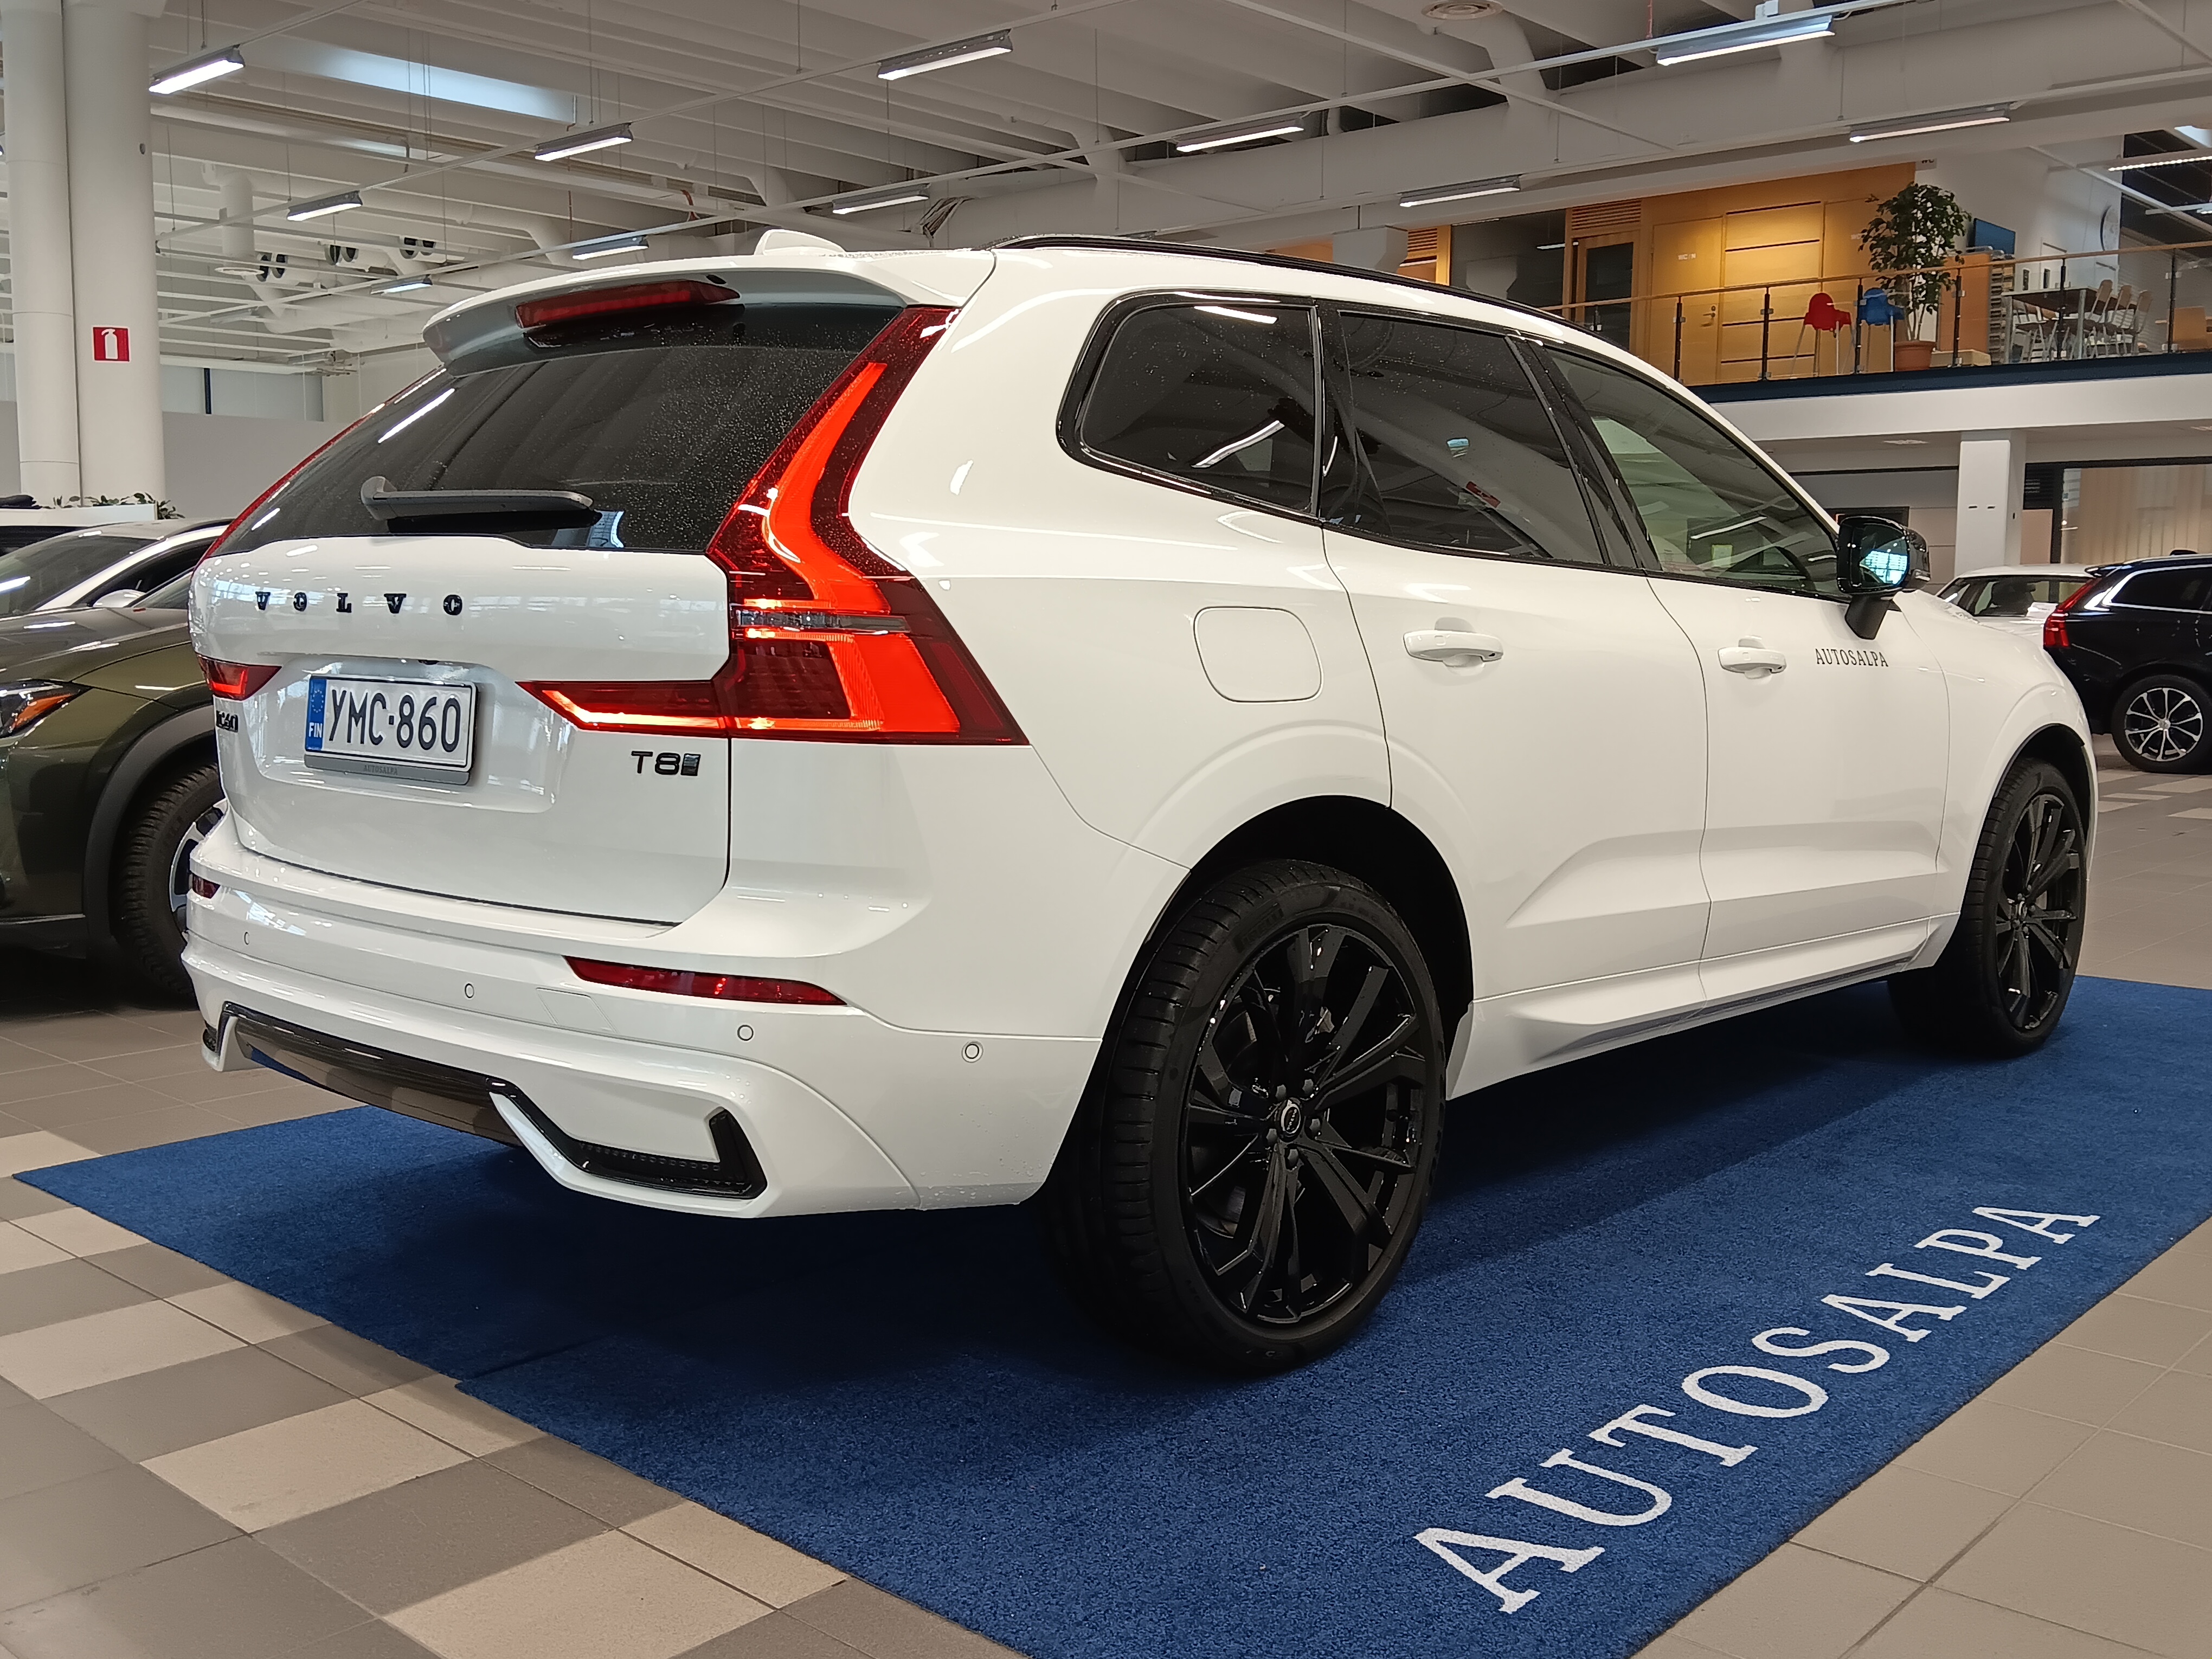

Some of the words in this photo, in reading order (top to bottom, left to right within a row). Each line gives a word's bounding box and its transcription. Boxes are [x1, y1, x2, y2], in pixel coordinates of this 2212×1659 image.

[255, 591, 462, 616] VOLVO
[1815, 648, 1888, 667] AUTOSALPA
[308, 722, 323, 738] FIN
[363, 764, 398, 776] AUTOSALPA
[631, 750, 681, 775] T8
[1412, 1205, 2100, 1615] AUTOSALPA
